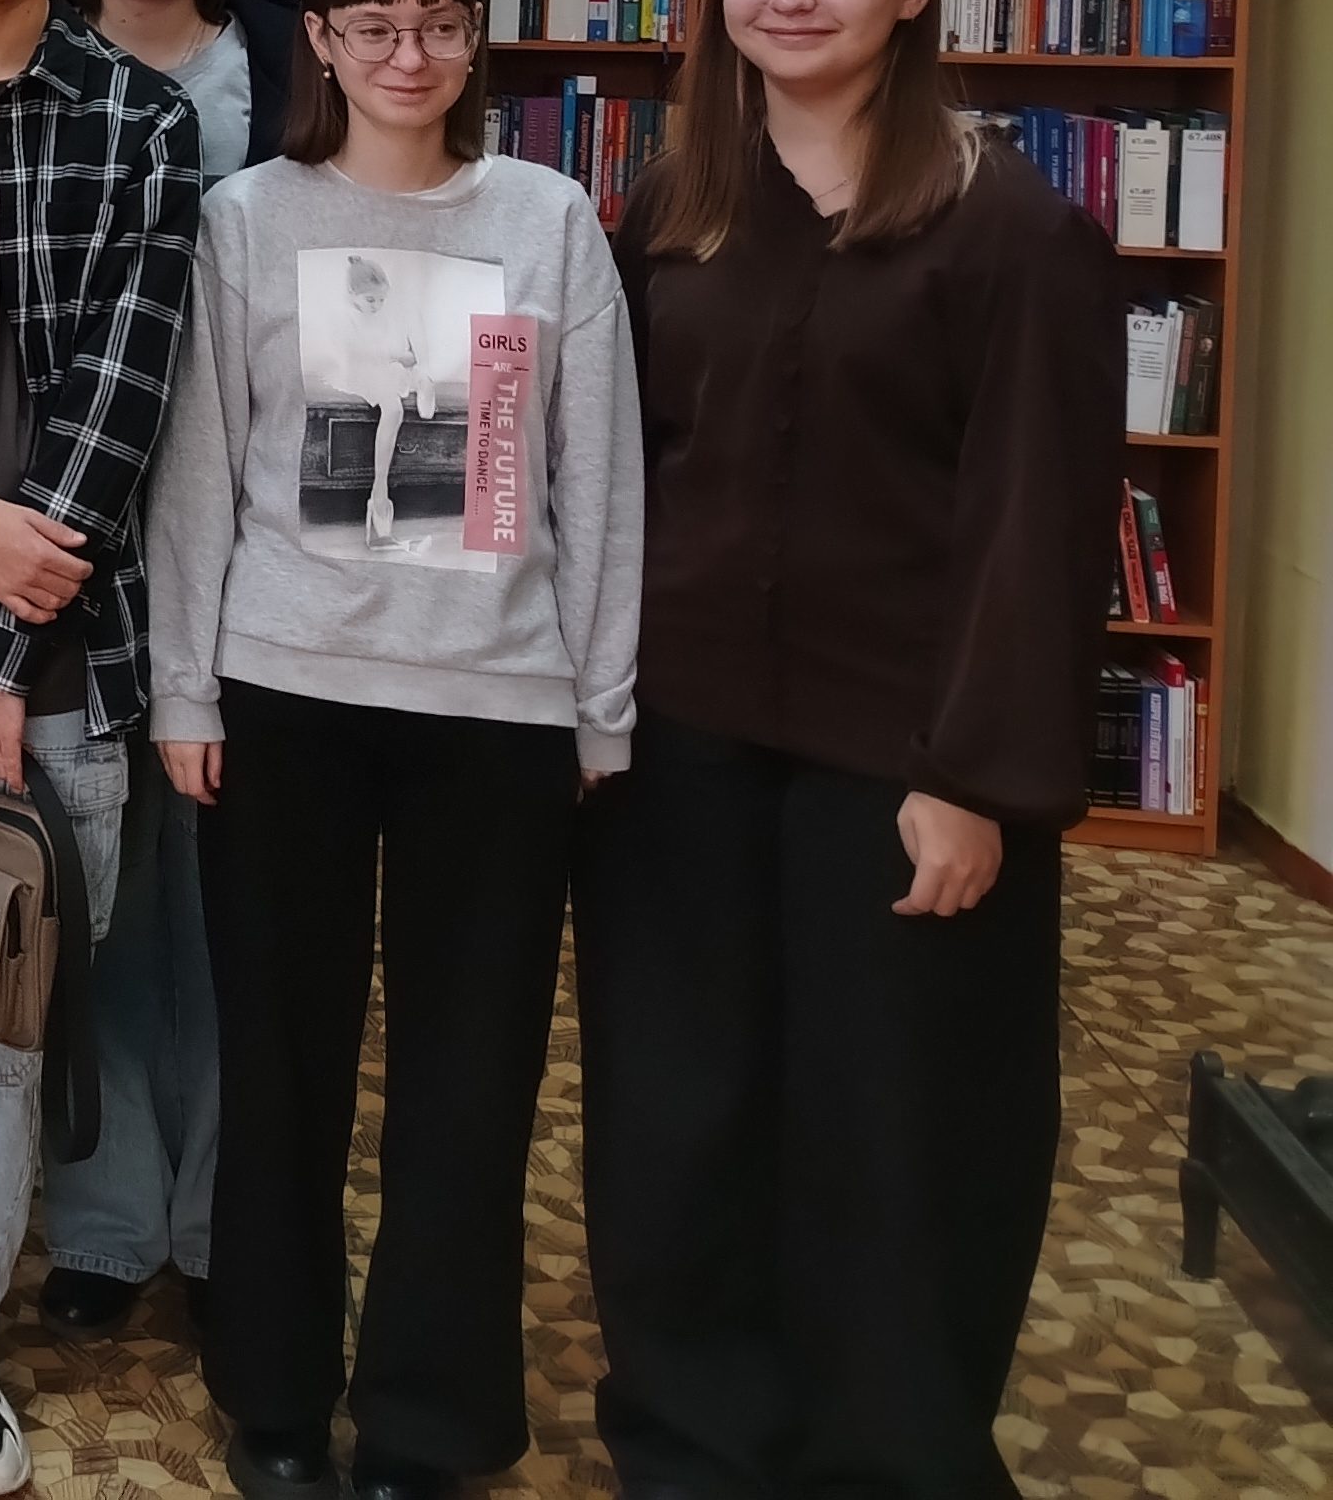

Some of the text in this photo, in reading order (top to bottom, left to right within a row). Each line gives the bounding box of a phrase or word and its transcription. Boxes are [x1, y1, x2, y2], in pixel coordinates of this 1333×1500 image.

[1188, 132, 1222, 142] 67.408
[1133, 319, 1164, 333] 67.7
[478, 333, 528, 353] GIRLS
[493, 362, 512, 374] ARE
[478, 400, 492, 430] TIME
[478, 431, 490, 448] TO
[493, 379, 518, 544] THE FUTURE
